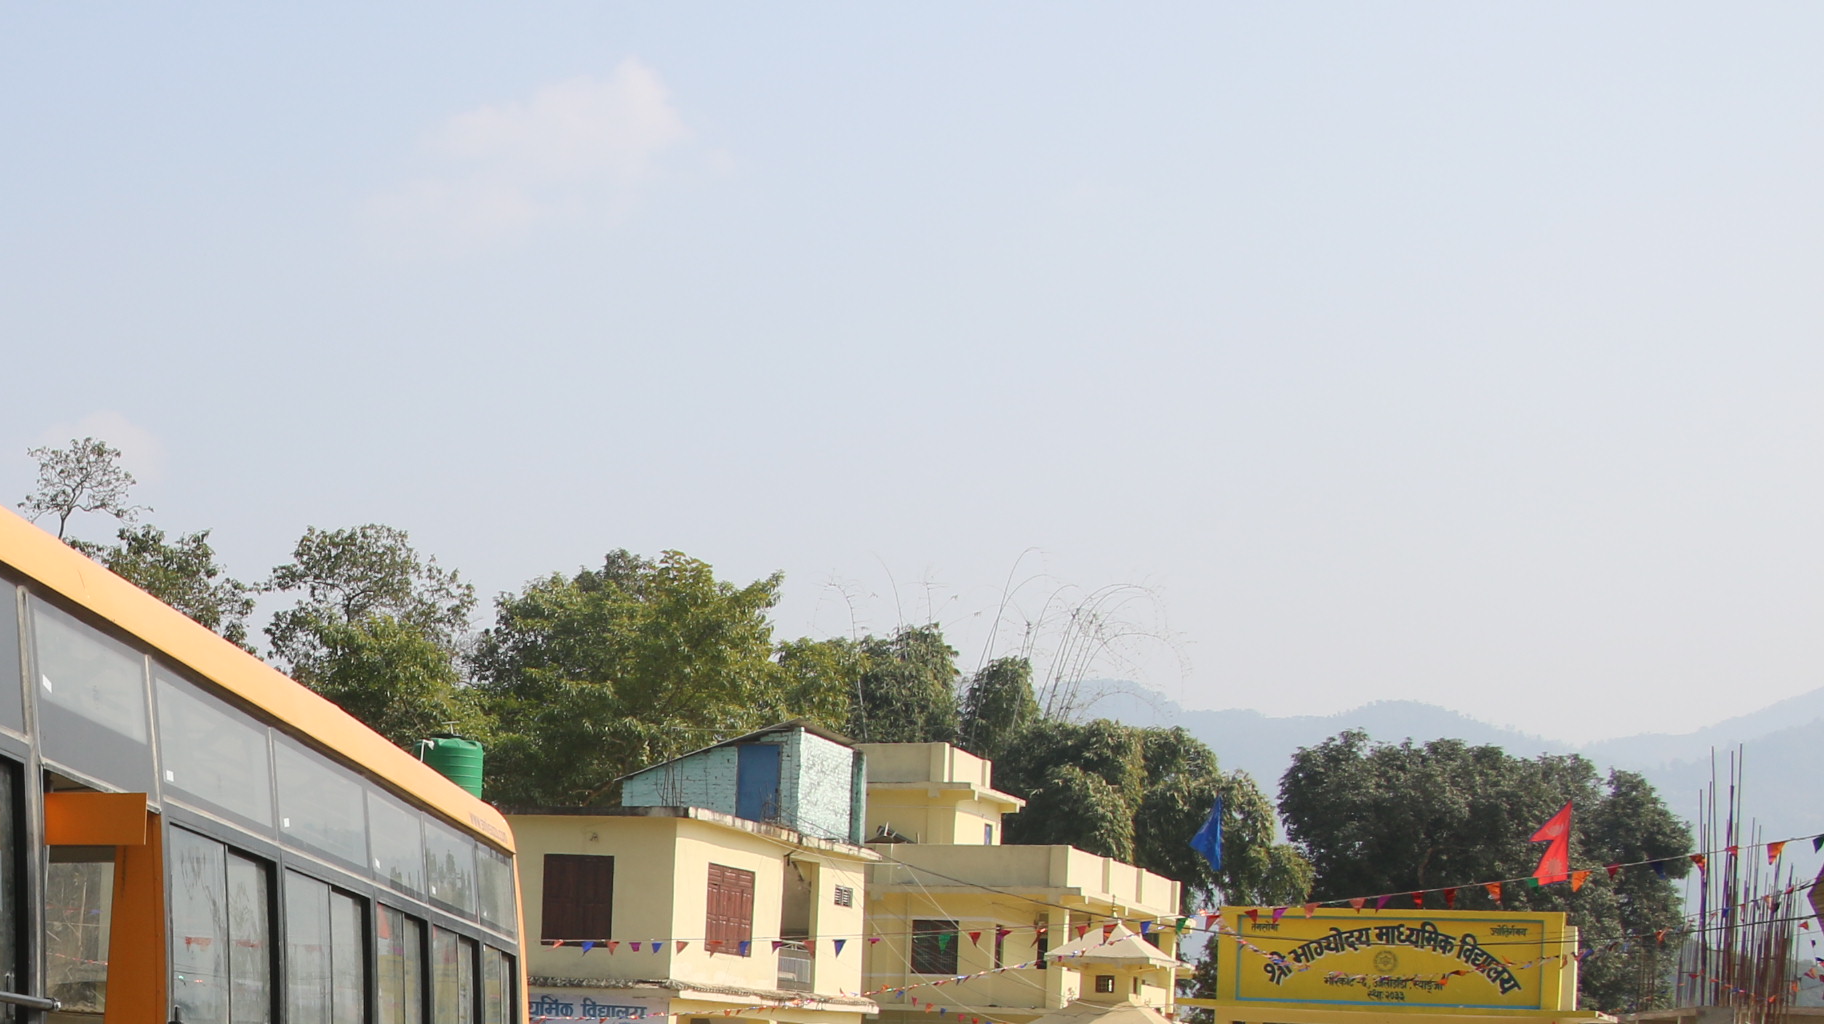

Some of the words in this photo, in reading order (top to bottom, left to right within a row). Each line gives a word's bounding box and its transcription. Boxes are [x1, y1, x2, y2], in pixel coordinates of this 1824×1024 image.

[1263, 951, 1293, 986] श्री
[1288, 927, 1371, 965] भाग्योदय
[1374, 920, 1457, 955] माध्यमिक
[1456, 933, 1522, 996] विद्यालय
[580, 997, 648, 1020] विद्यालय
